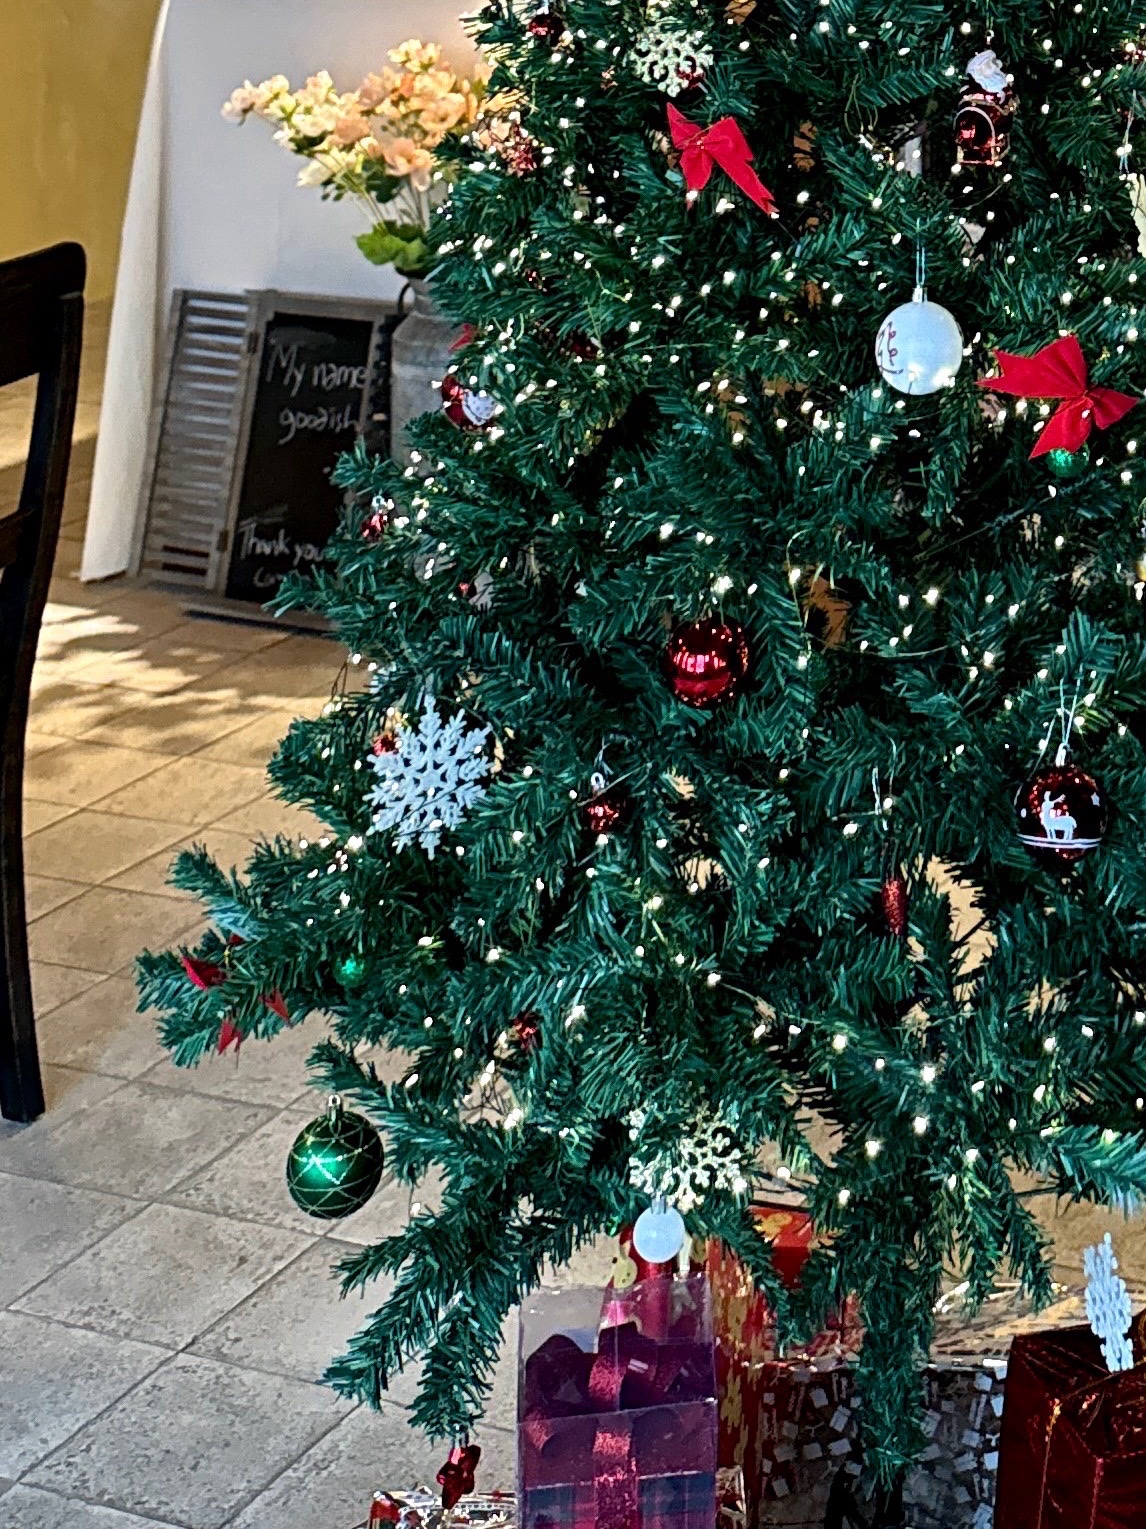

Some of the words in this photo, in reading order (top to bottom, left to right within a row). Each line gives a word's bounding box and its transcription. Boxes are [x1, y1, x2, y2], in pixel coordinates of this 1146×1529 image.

[265, 344, 307, 398] My
[312, 361, 369, 392] name
[238, 519, 292, 560] Thank
[293, 543, 326, 568] you
